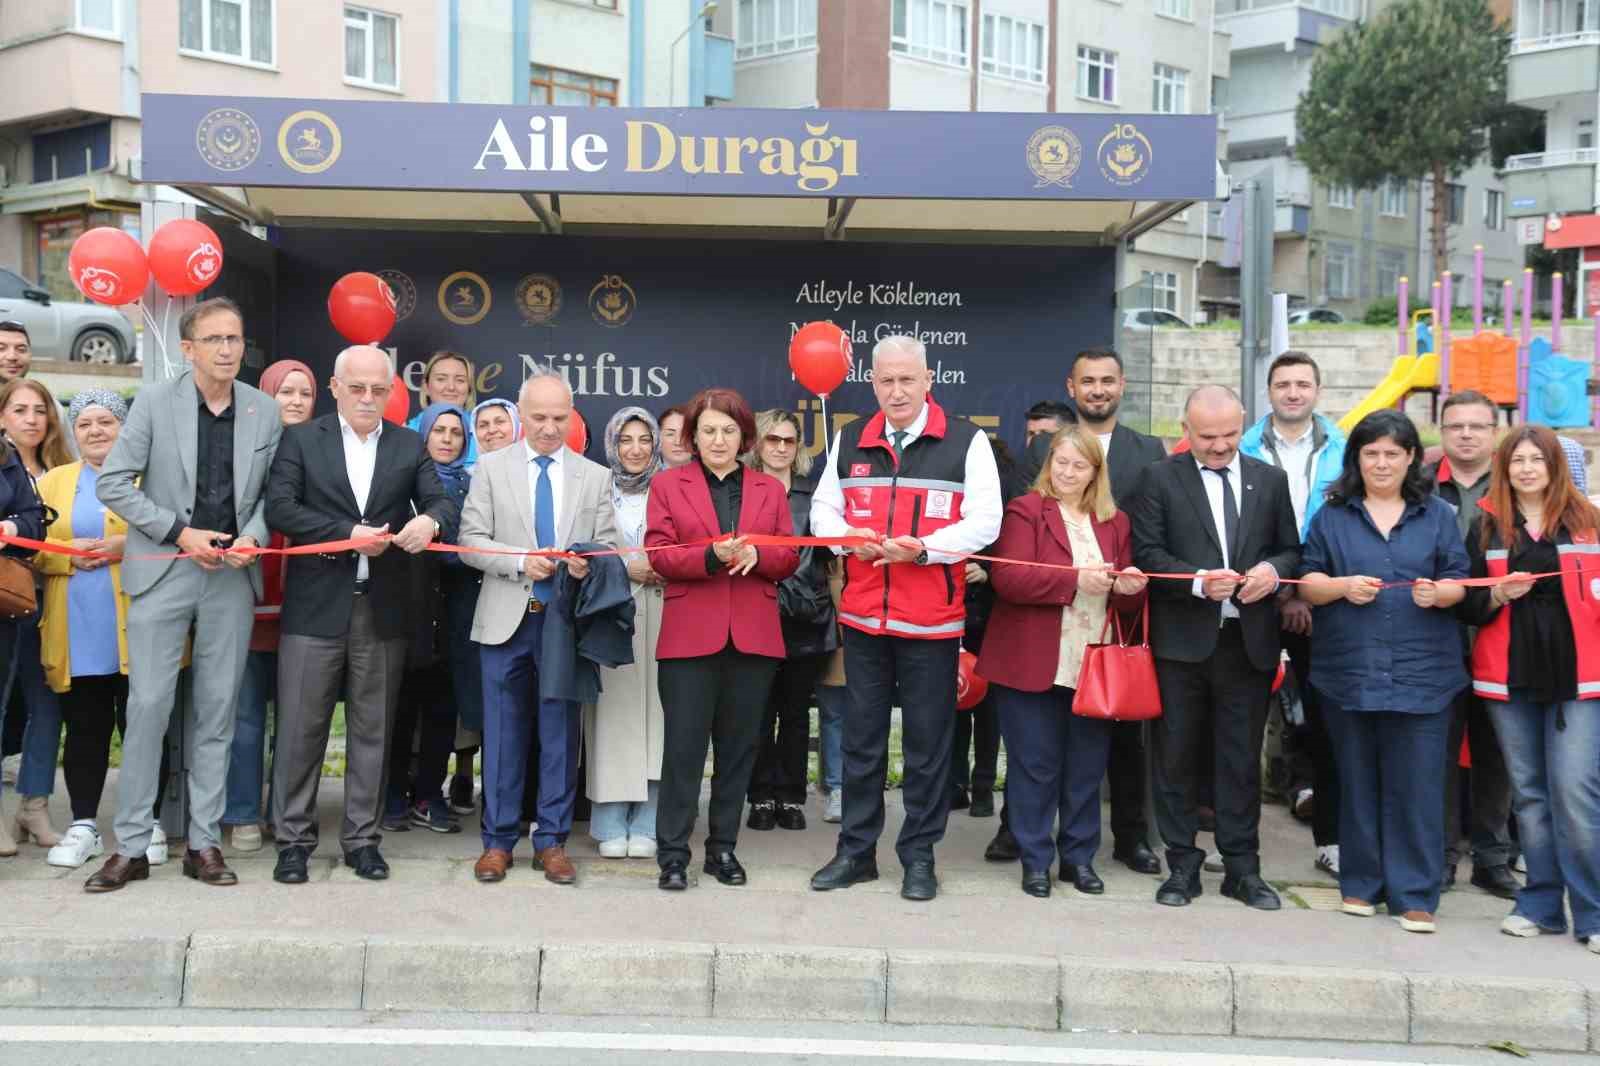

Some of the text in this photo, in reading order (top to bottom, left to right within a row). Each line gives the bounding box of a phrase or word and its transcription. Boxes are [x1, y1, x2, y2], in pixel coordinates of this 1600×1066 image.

[1114, 123, 1136, 139] 10
[472, 116, 859, 191] Aile Durağı
[796, 280, 962, 311] Aileyle Köklenen
[518, 352, 670, 397] Nüfus
